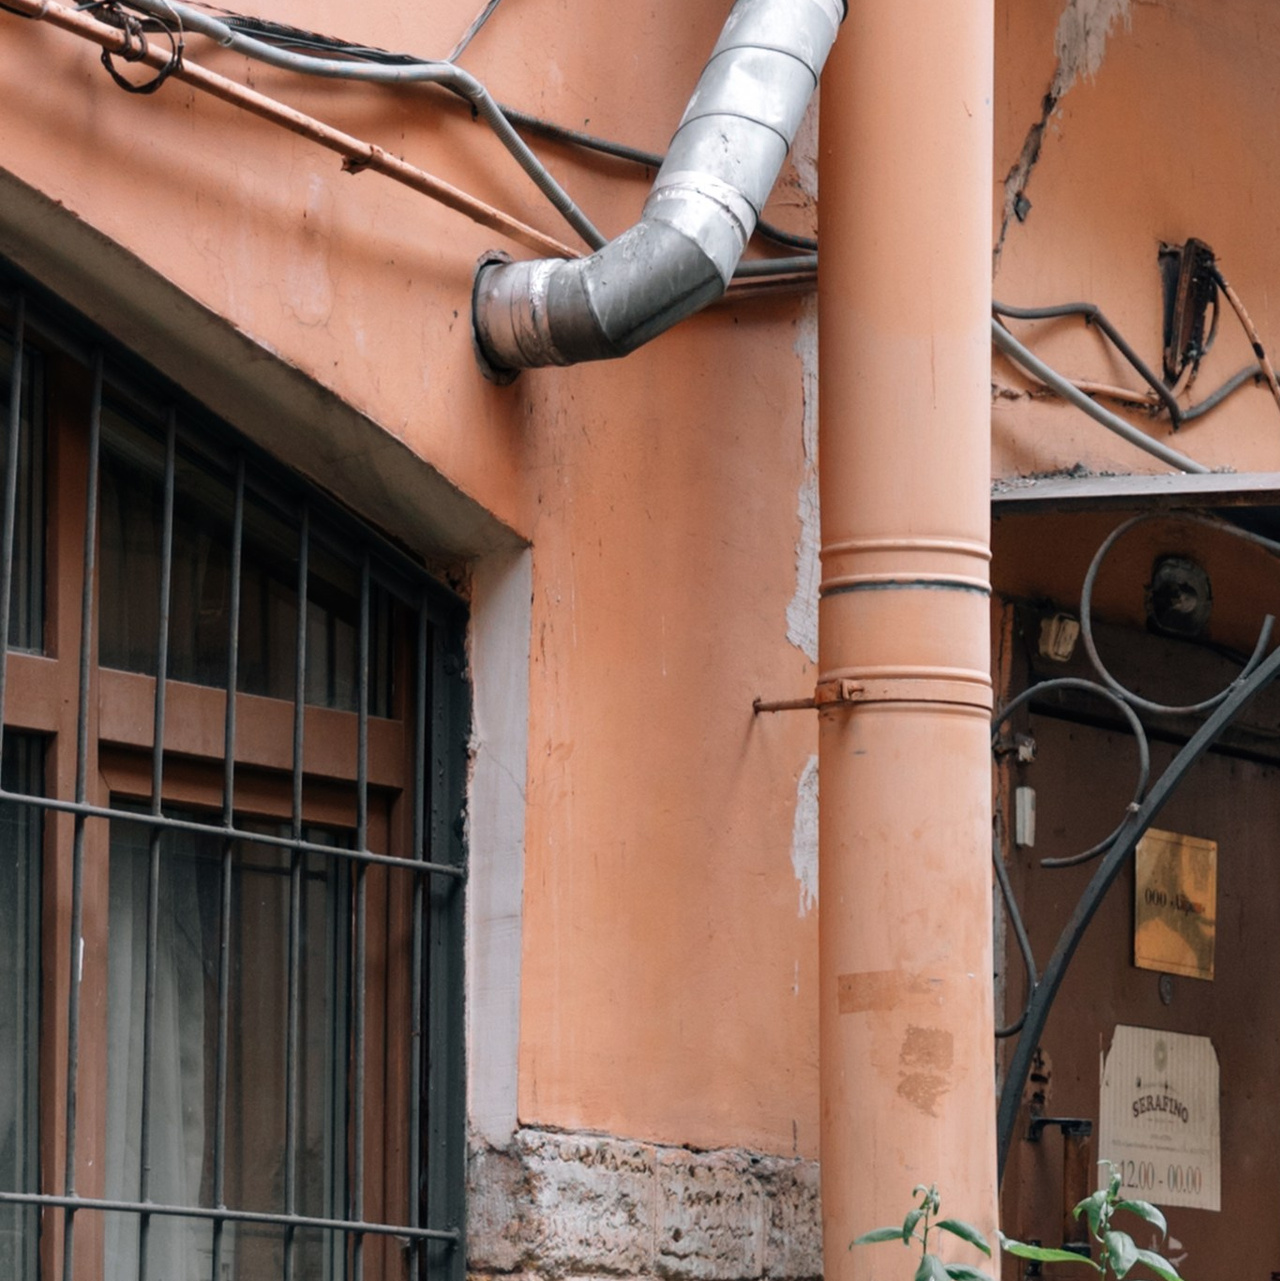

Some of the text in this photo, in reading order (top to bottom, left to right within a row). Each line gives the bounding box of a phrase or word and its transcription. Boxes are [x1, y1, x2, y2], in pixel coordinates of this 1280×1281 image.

[1132, 1095, 1189, 1124] SERAFINO
[1121, 1160, 1155, 1190] 12.00
[1167, 1164, 1202, 1194] 00.00
